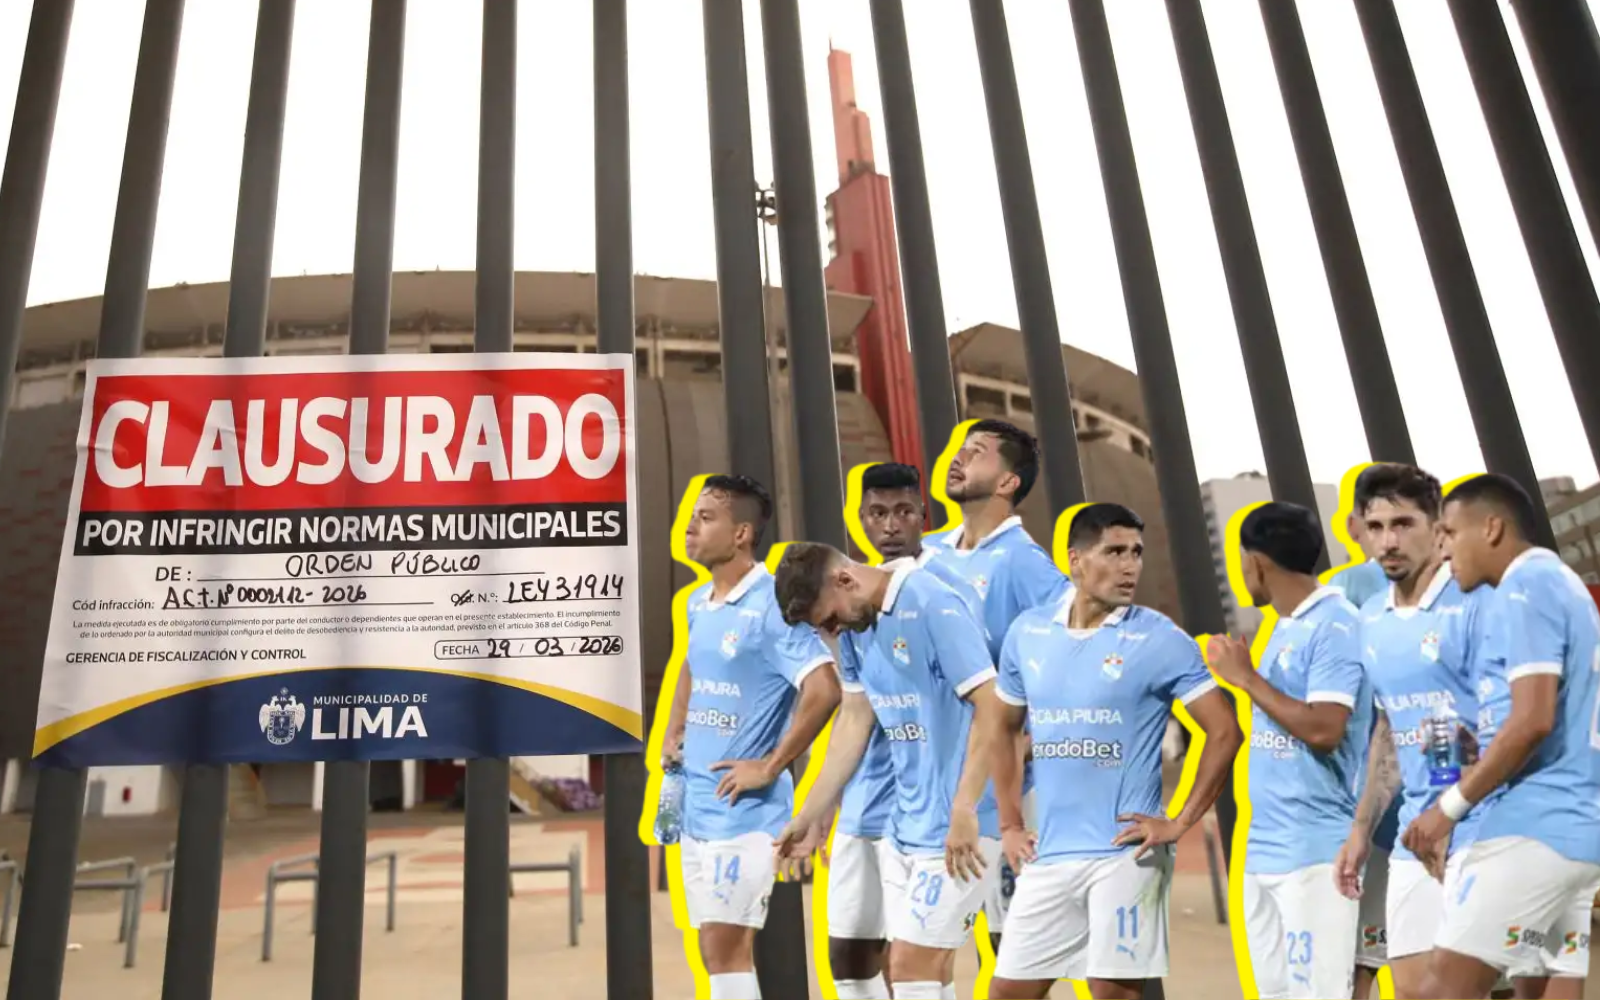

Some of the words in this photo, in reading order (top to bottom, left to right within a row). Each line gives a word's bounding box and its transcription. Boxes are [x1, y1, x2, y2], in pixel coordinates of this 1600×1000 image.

[95, 393, 621, 488] CLAUSURADO
[83, 519, 144, 547] POR
[150, 517, 293, 547] INFRINGIR
[300, 513, 424, 544] NORMAS
[432, 510, 621, 541] MUNICIPALES
[285, 552, 372, 578] ORDEN
[322, 584, 367, 603] 2026
[508, 578, 550, 603] LEY
[556, 573, 624, 600] 31914
[72, 599, 96, 611] Cód
[99, 597, 155, 611] infracción:
[66, 651, 126, 663] GERENCIA
[128, 651, 145, 662] DE
[147, 648, 238, 662] FISCALIZACIÓN
[240, 649, 249, 660] Y
[251, 648, 307, 660] CONTROL
[442, 644, 480, 655] FECHA
[487, 638, 511, 658] 29
[534, 637, 564, 657] 03
[579, 636, 621, 655] 2026
[313, 694, 409, 705] MUNICIPALIDAD
[413, 693, 428, 703] DE
[311, 705, 428, 740] LIMA
[1073, 708, 1124, 726] PIURA
[714, 855, 740, 885] 14
[910, 870, 944, 906] 28
[1116, 905, 1140, 940] 11
[1286, 930, 1313, 965] 23
